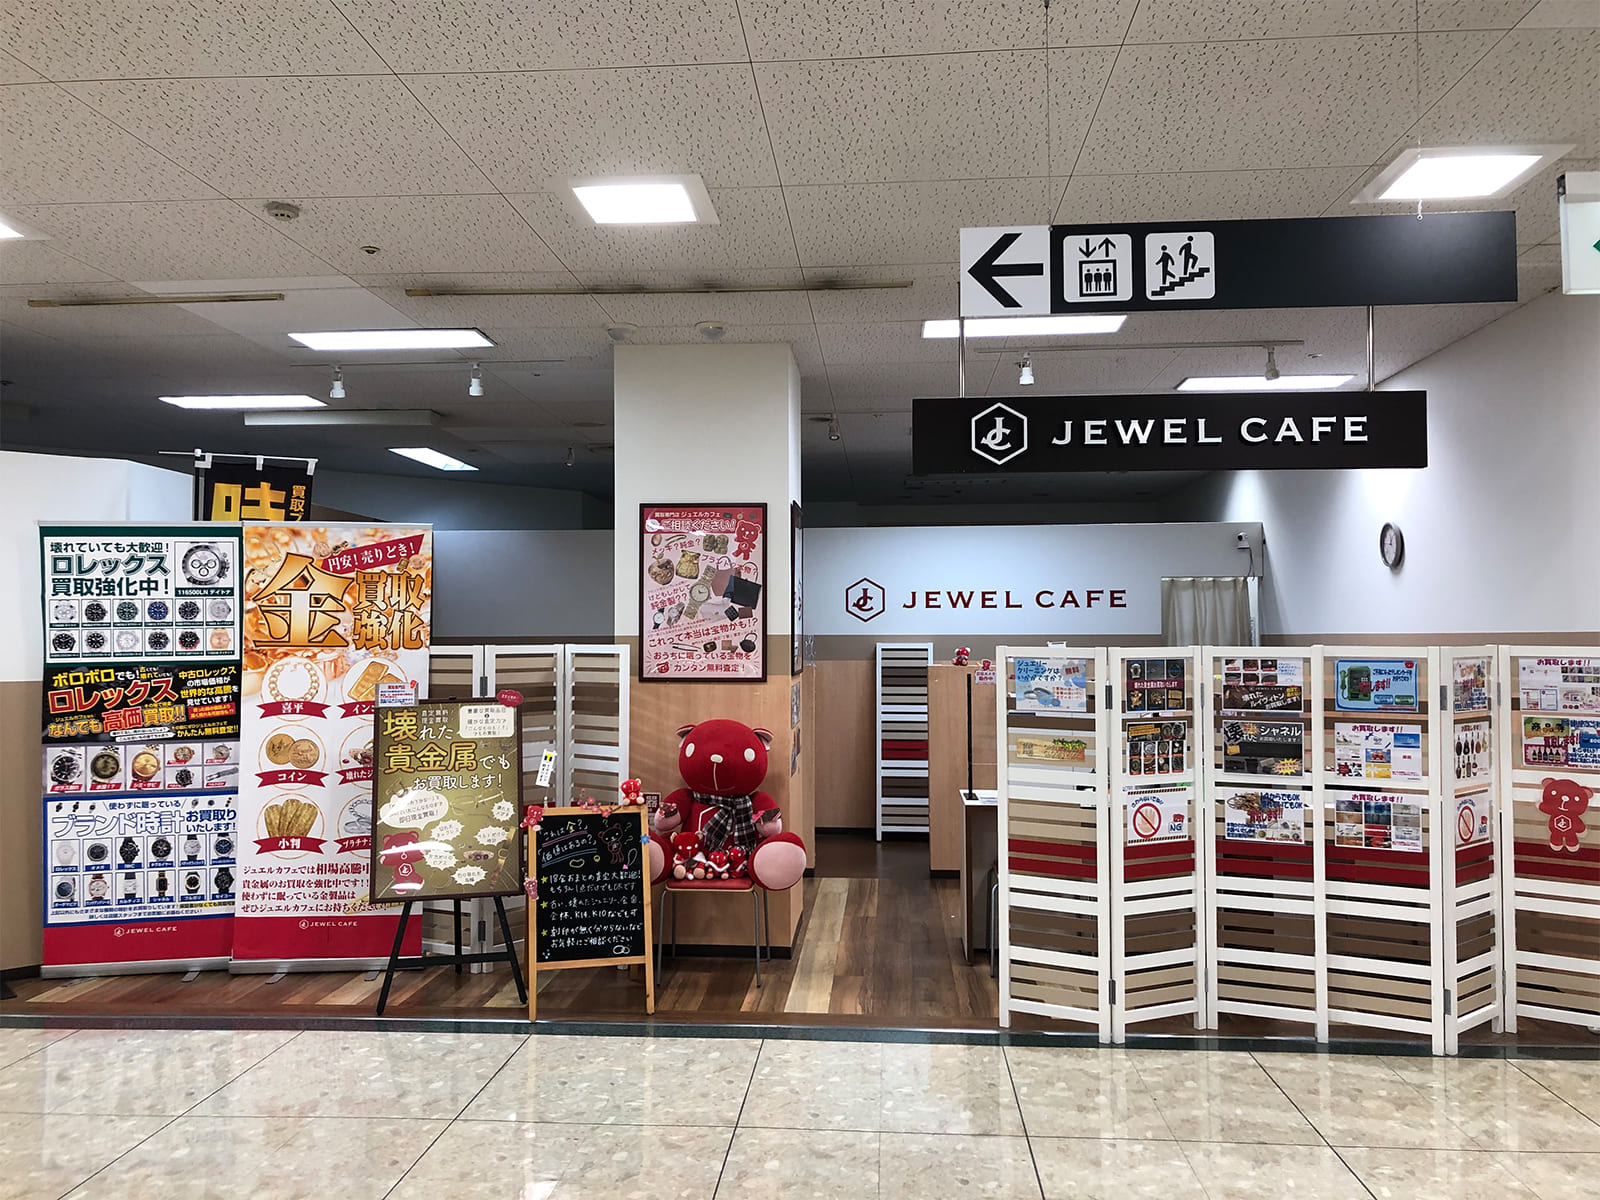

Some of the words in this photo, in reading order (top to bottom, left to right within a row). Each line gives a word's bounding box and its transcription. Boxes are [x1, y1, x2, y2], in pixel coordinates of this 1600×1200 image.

[1051, 417, 1223, 446] JEWEL
[1239, 415, 1369, 444] CAFE
[50, 542, 169, 553] 壊れていても大歓迎!
[50, 553, 171, 576] ロレックス
[51, 577, 169, 597] 買取強化中!
[354, 570, 425, 611] 買取
[252, 551, 355, 648] 金
[902, 590, 1023, 609] JEWEL
[1035, 589, 1127, 609] CAFE
[353, 610, 425, 651] 強化
[48, 678, 179, 714] ロレックス
[1260, 726, 1302, 737] シャネル
[384, 741, 511, 774] 貴金属でも
[277, 772, 307, 782] コイン
[412, 773, 503, 791] お買取します!
[52, 810, 185, 838] ブランド時計
[278, 838, 301, 849] 小判
[125, 927, 154, 935] JEWEL
